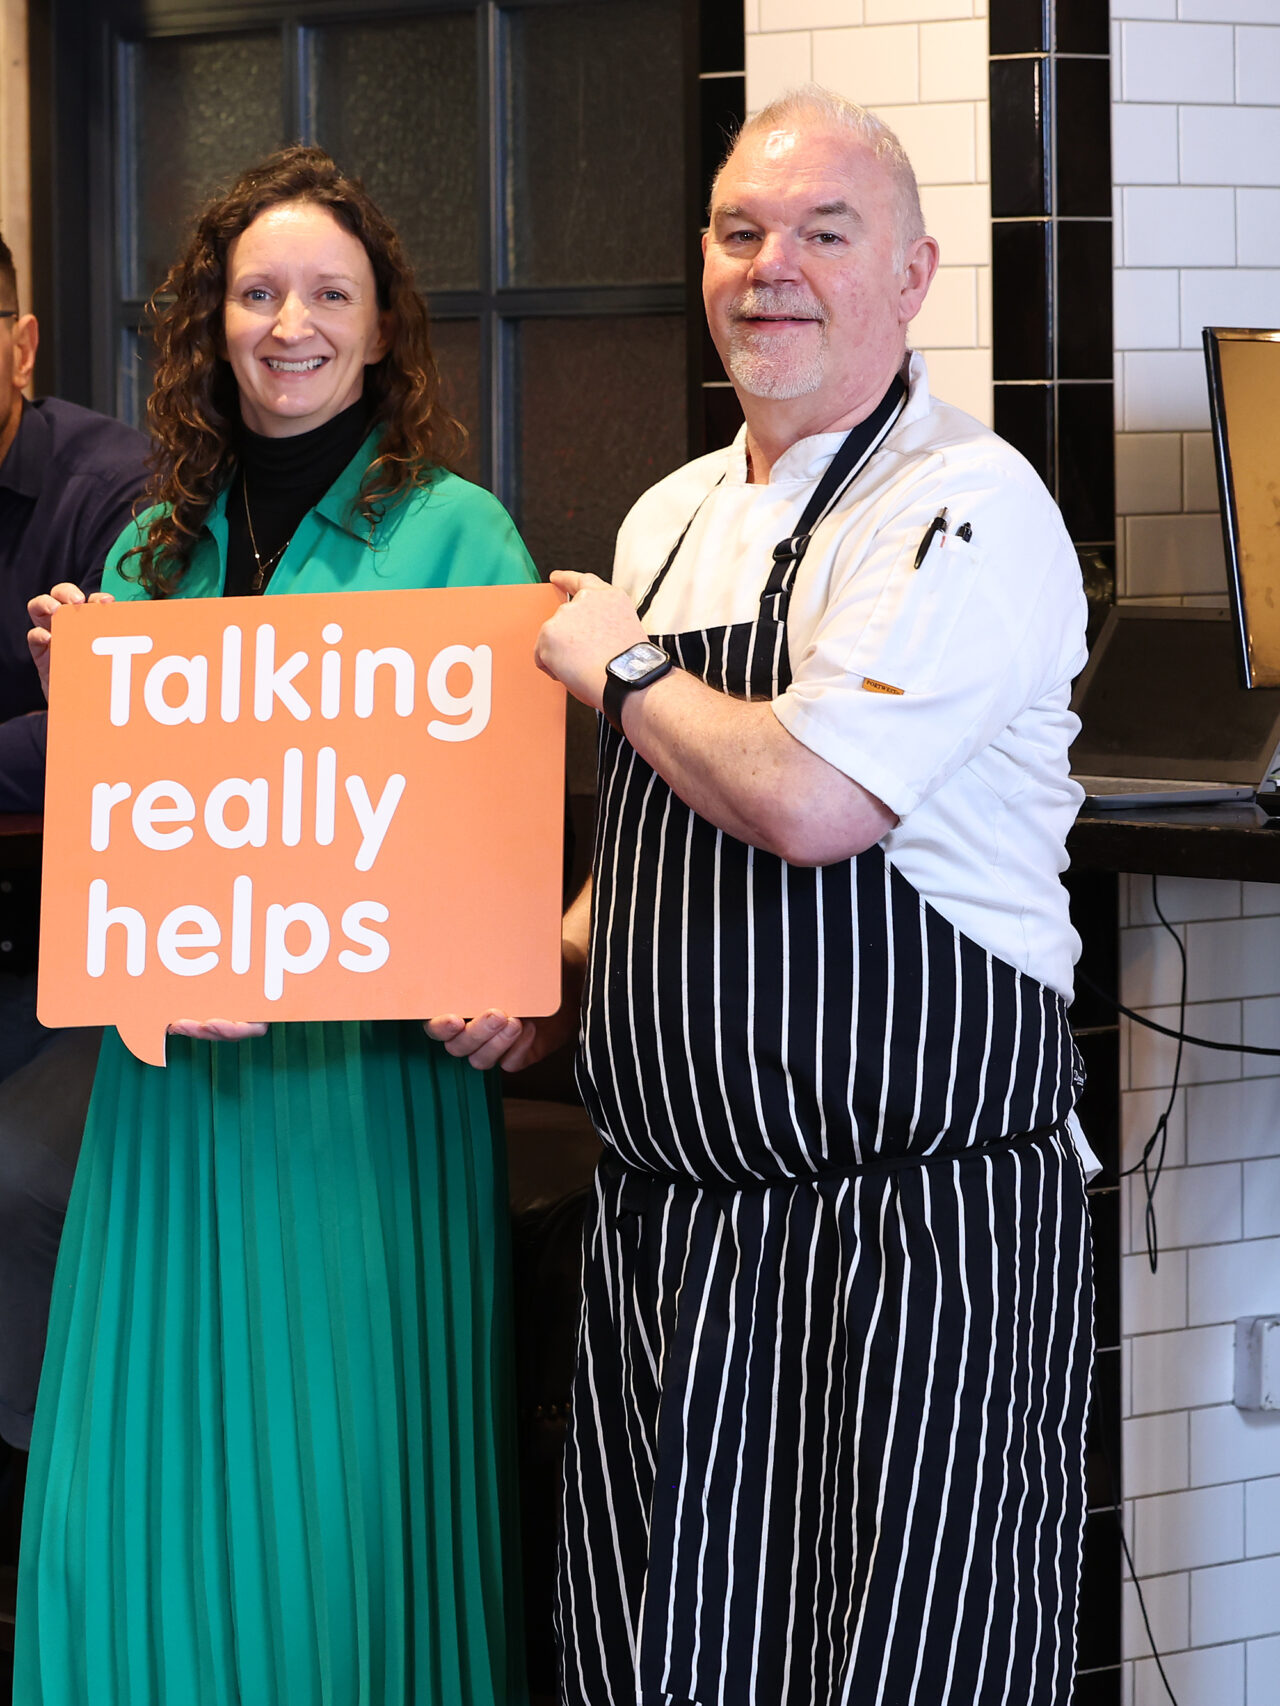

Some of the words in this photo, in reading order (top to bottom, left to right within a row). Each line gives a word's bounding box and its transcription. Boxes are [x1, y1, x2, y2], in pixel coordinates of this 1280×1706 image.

[91, 622, 493, 743] Talking
[90, 746, 407, 872] really
[86, 875, 391, 1001] helps
